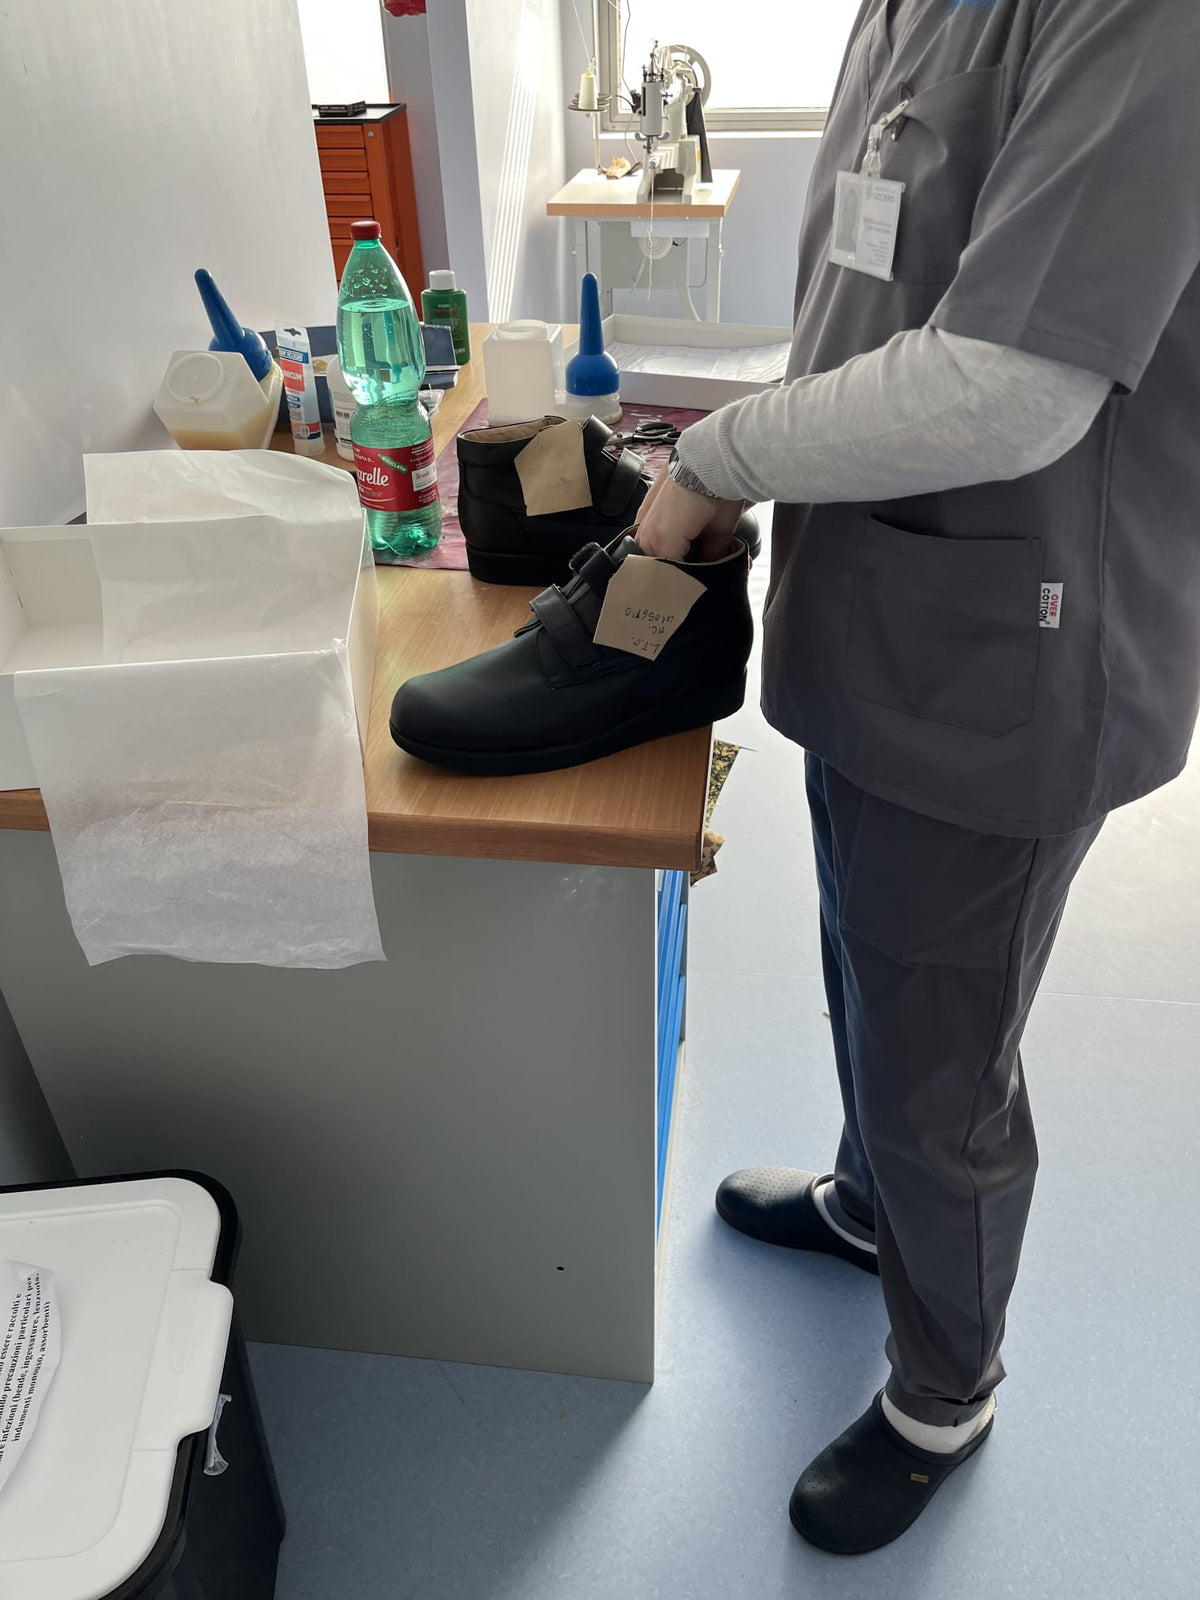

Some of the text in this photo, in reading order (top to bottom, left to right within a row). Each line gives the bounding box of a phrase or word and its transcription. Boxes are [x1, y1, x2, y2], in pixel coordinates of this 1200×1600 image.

[356, 467, 390, 487] arelle
[1040, 587, 1050, 622] COTTON
[1050, 594, 1059, 617] OVER
[0, 1334, 13, 1360] essere
[8, 1300, 21, 1332] raccolti
[4, 1342, 23, 1392] precauzioni
[18, 1293, 32, 1340] particolari
[0, 1404, 18, 1442] infezioni
[12, 1370, 28, 1402] (bende,
[21, 1316, 40, 1369] ingessature,
[11, 1301, 51, 1442] indumenti monouso, assorbenti)
